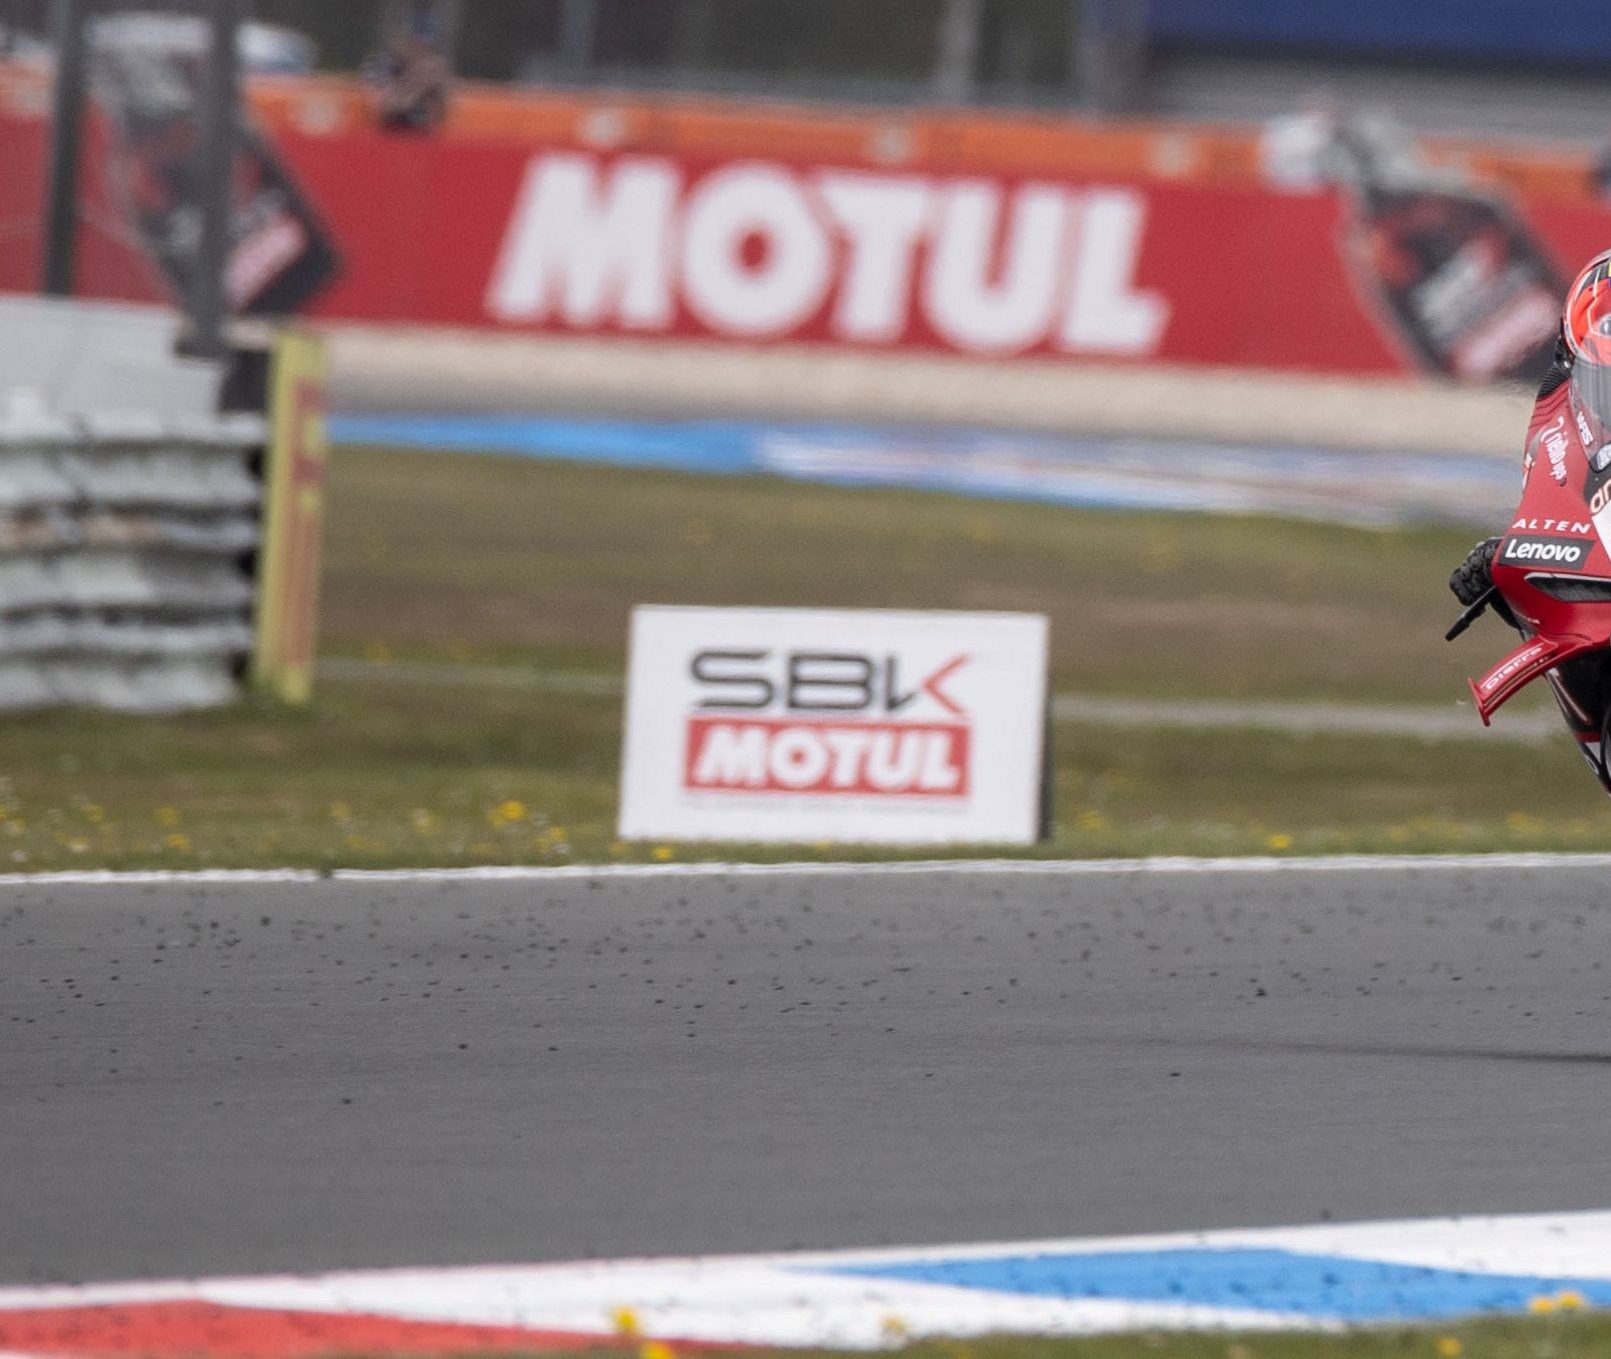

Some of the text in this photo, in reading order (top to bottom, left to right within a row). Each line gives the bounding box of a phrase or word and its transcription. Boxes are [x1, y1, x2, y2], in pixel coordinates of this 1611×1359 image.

[485, 151, 1173, 358] MOTUL
[1504, 539, 1581, 563] Lenovo
[1512, 518, 1591, 534] ALTEN
[689, 650, 972, 716] SBK
[692, 724, 962, 790] MOTUL
